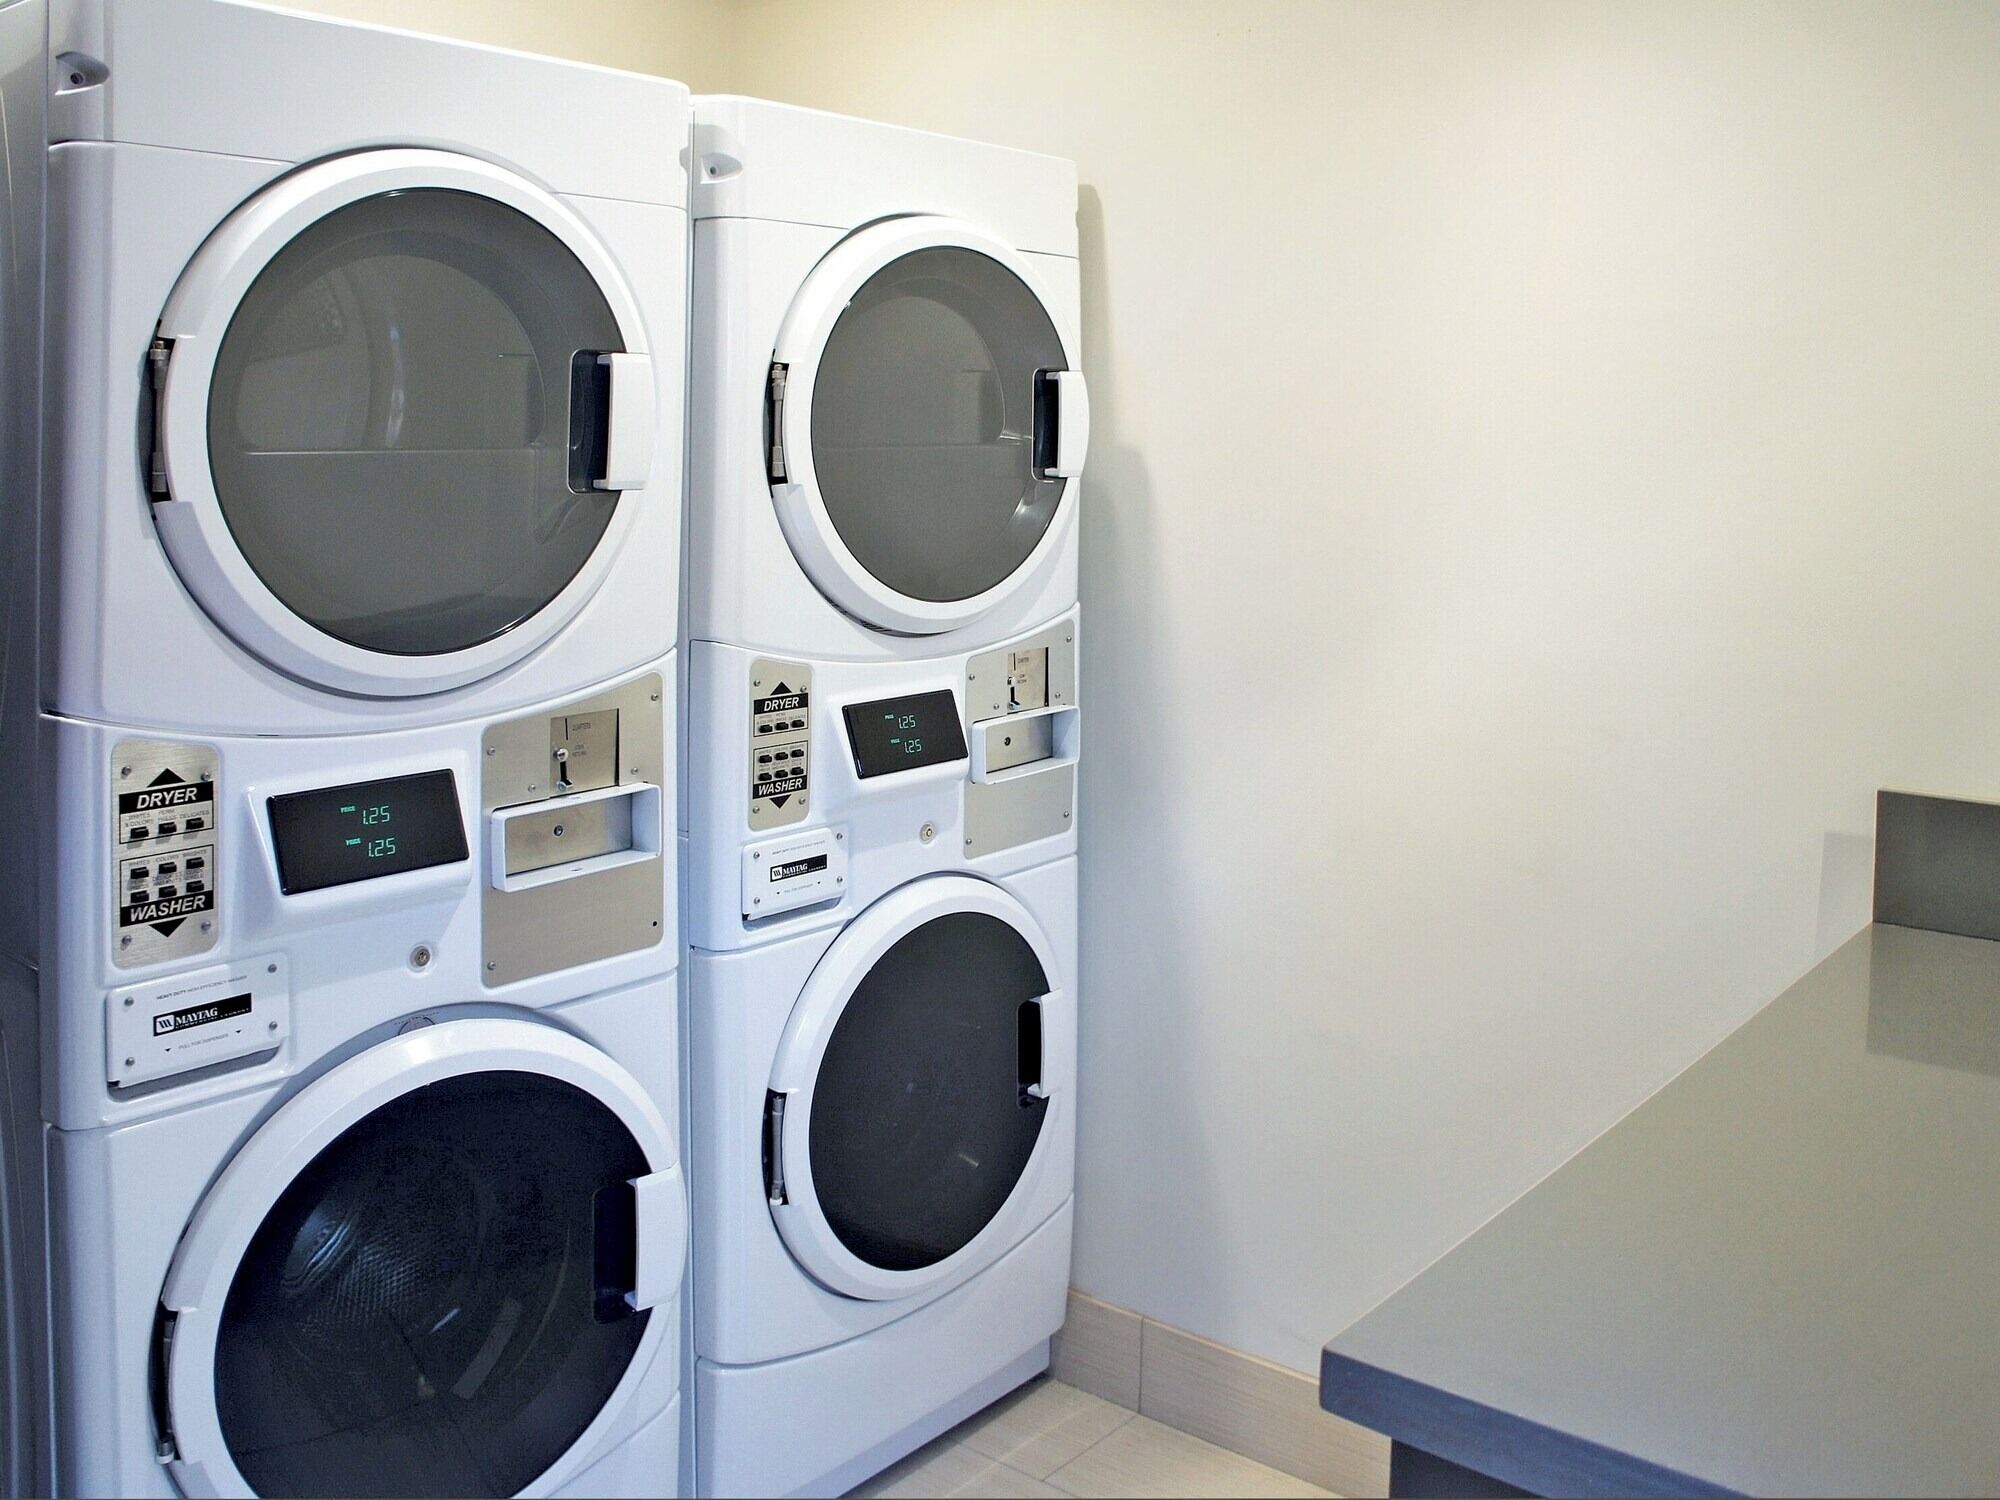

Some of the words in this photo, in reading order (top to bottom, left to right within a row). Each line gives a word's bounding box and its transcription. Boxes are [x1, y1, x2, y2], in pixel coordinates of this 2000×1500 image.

[764, 697, 799, 712] DRYER
[758, 778, 803, 796] WASHER
[137, 787, 198, 810] DRYER
[363, 805, 390, 824] 1.25
[368, 837, 396, 857] 1.25
[130, 894, 206, 922] WASHER
[175, 1007, 218, 1025] MAYTAG
